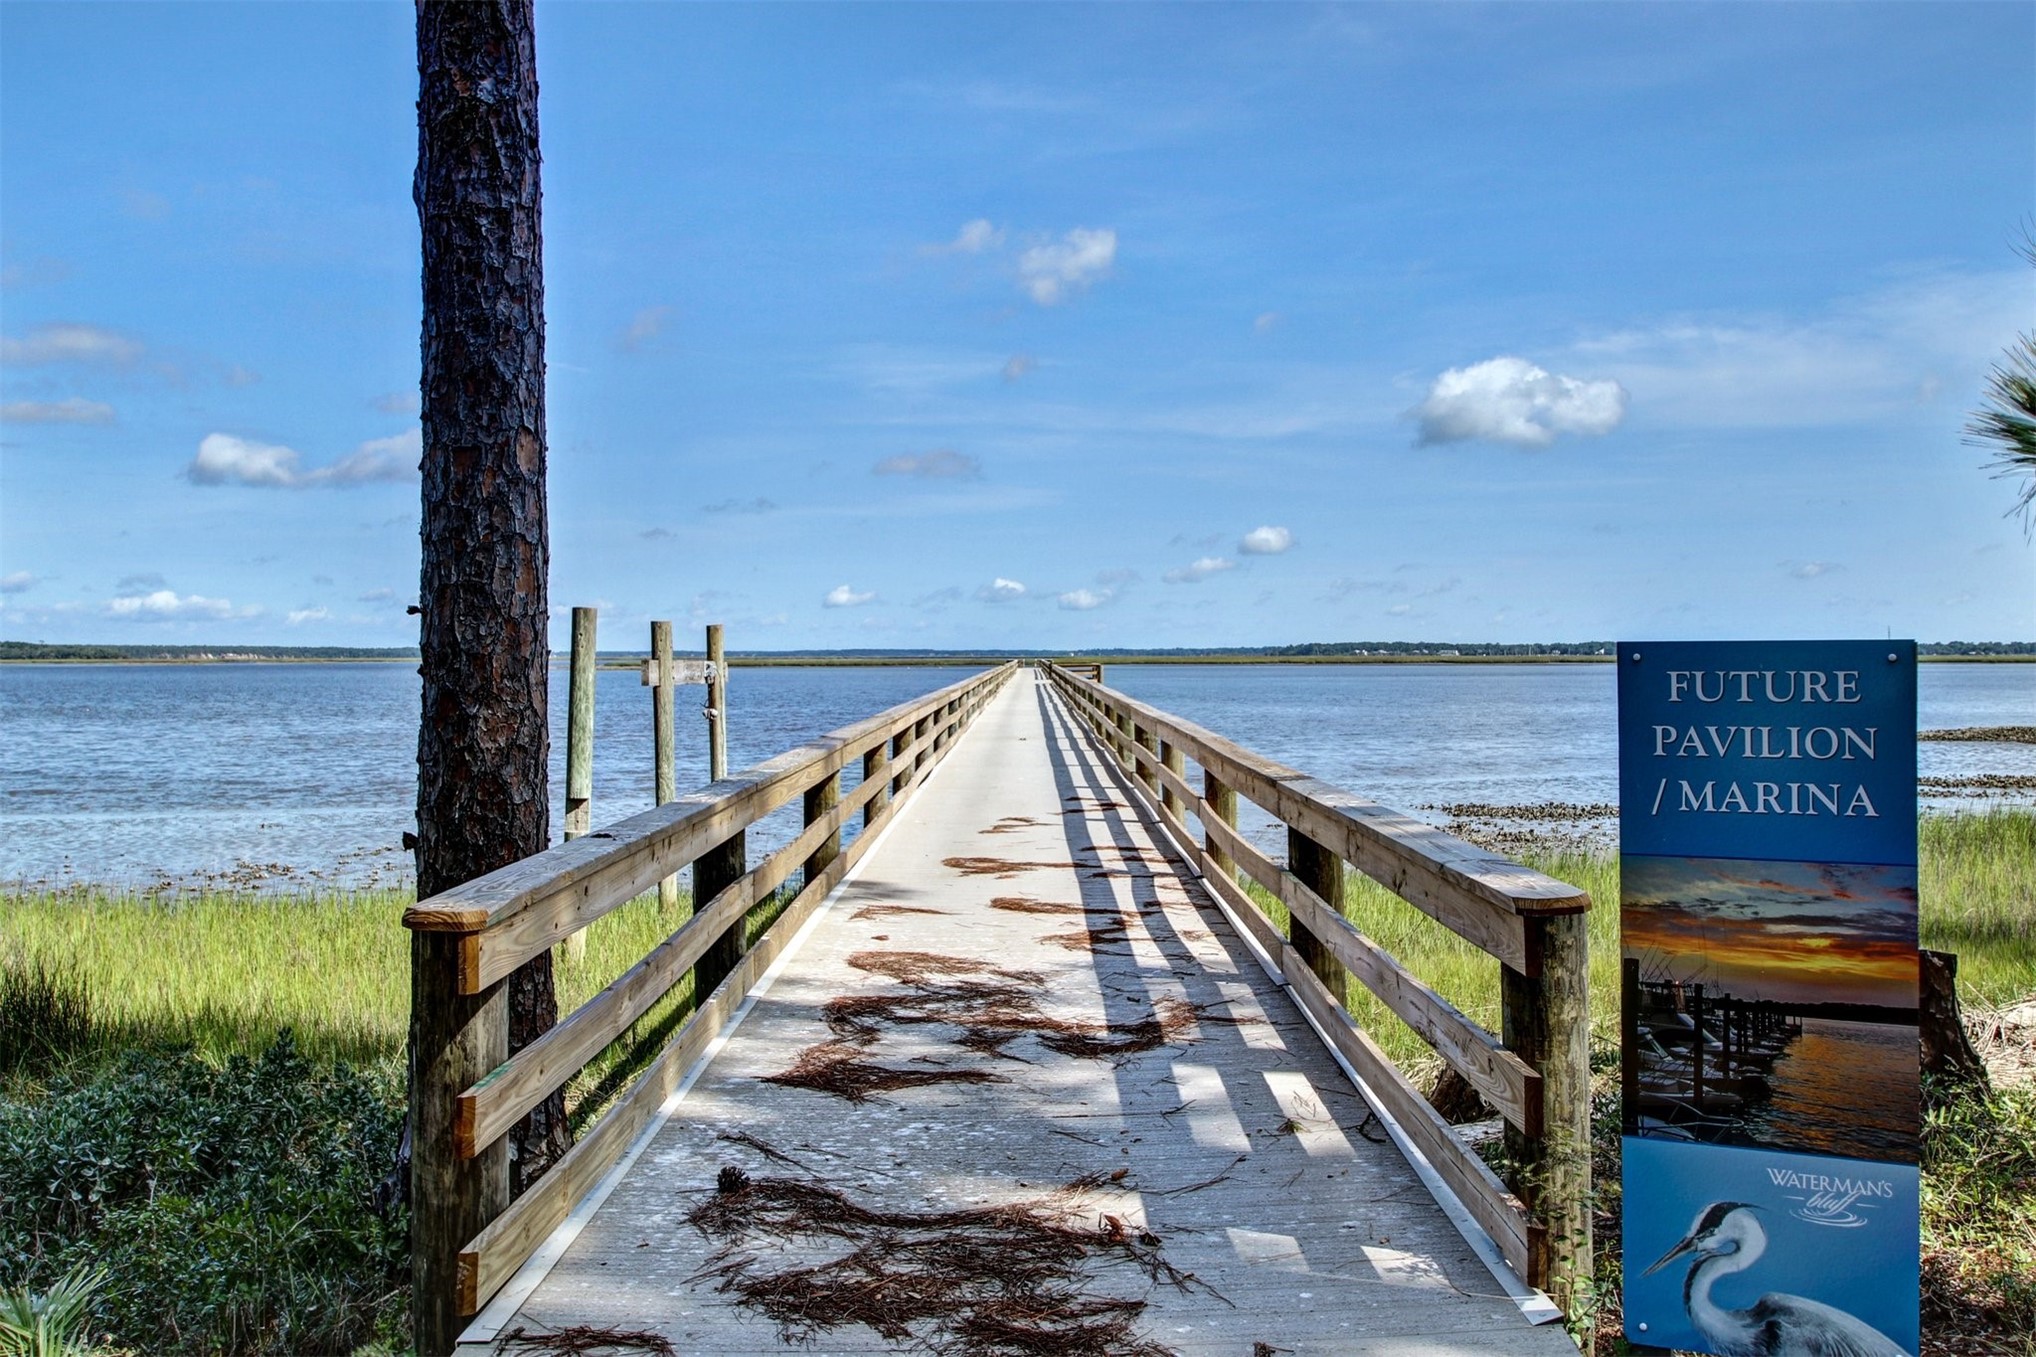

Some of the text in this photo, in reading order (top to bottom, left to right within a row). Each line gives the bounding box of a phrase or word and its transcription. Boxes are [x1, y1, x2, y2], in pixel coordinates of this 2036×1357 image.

[1667, 670, 1862, 703] FUTURE
[1652, 725, 1878, 760] PAVILION
[1678, 780, 1880, 817] MARINA
[1766, 1167, 1894, 1198] WATERMAN'S
[1806, 1191, 1861, 1216] bluff
